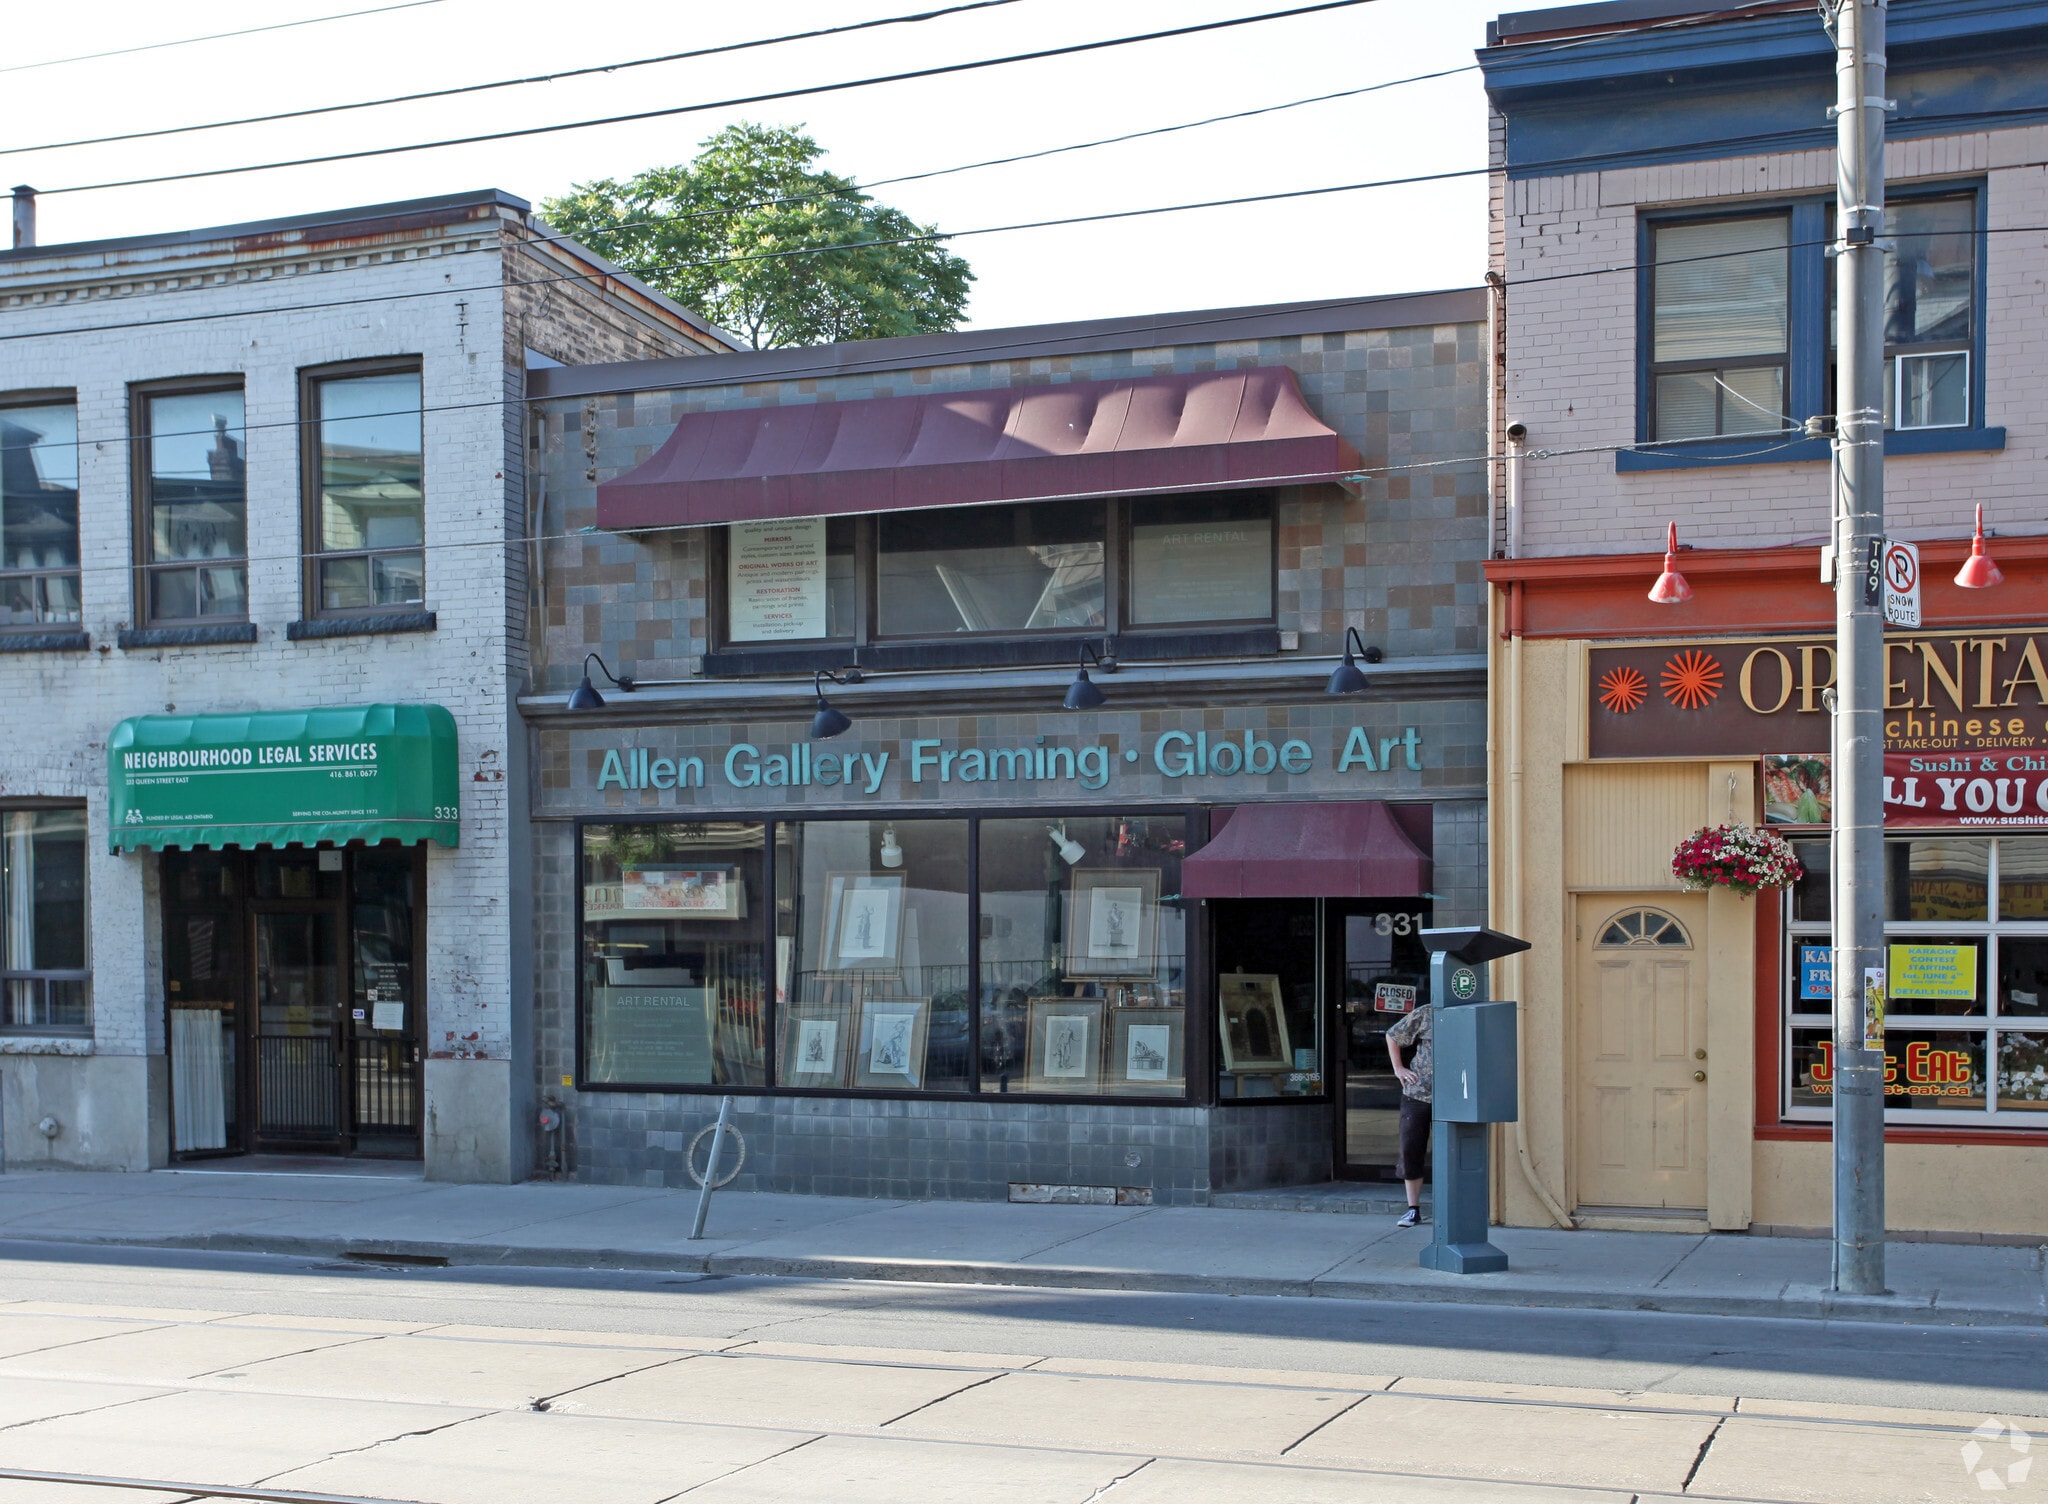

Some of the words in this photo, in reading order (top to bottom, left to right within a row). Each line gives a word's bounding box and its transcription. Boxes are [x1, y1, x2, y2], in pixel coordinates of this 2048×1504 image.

[775, 525, 792, 533] unique
[1163, 533, 1189, 545] ART
[1194, 530, 1249, 544] RENTAL
[756, 587, 801, 595] RESTORATION
[1889, 594, 1914, 608] SNOW
[1888, 607, 1916, 622] ROUTE
[1739, 637, 2048, 714] ORENTA
[1885, 710, 2025, 738] chinese
[1897, 738, 1959, 749] TAKE-OUT
[1976, 737, 2036, 748] DELIVERY
[124, 748, 253, 769] NEIGHBOURHOOD
[258, 745, 303, 765] LEGAL
[309, 742, 378, 762] SERVICES
[596, 747, 705, 791] Allen
[724, 742, 889, 794] Gallery
[911, 738, 1110, 790] Framing
[1154, 728, 1314, 778] Globe
[1337, 726, 1422, 773] Art
[1909, 757, 1972, 772] Sushi
[1979, 757, 1998, 772] &
[156, 777, 175, 785] STREET
[1935, 777, 2027, 814] YOU
[434, 806, 458, 820] 333
[1375, 913, 1423, 936] 331
[1379, 986, 1413, 1000] CLOSED
[1895, 988, 1935, 996] DETAILS
[616, 996, 640, 1007] ART
[644, 996, 691, 1007] RENTAL
